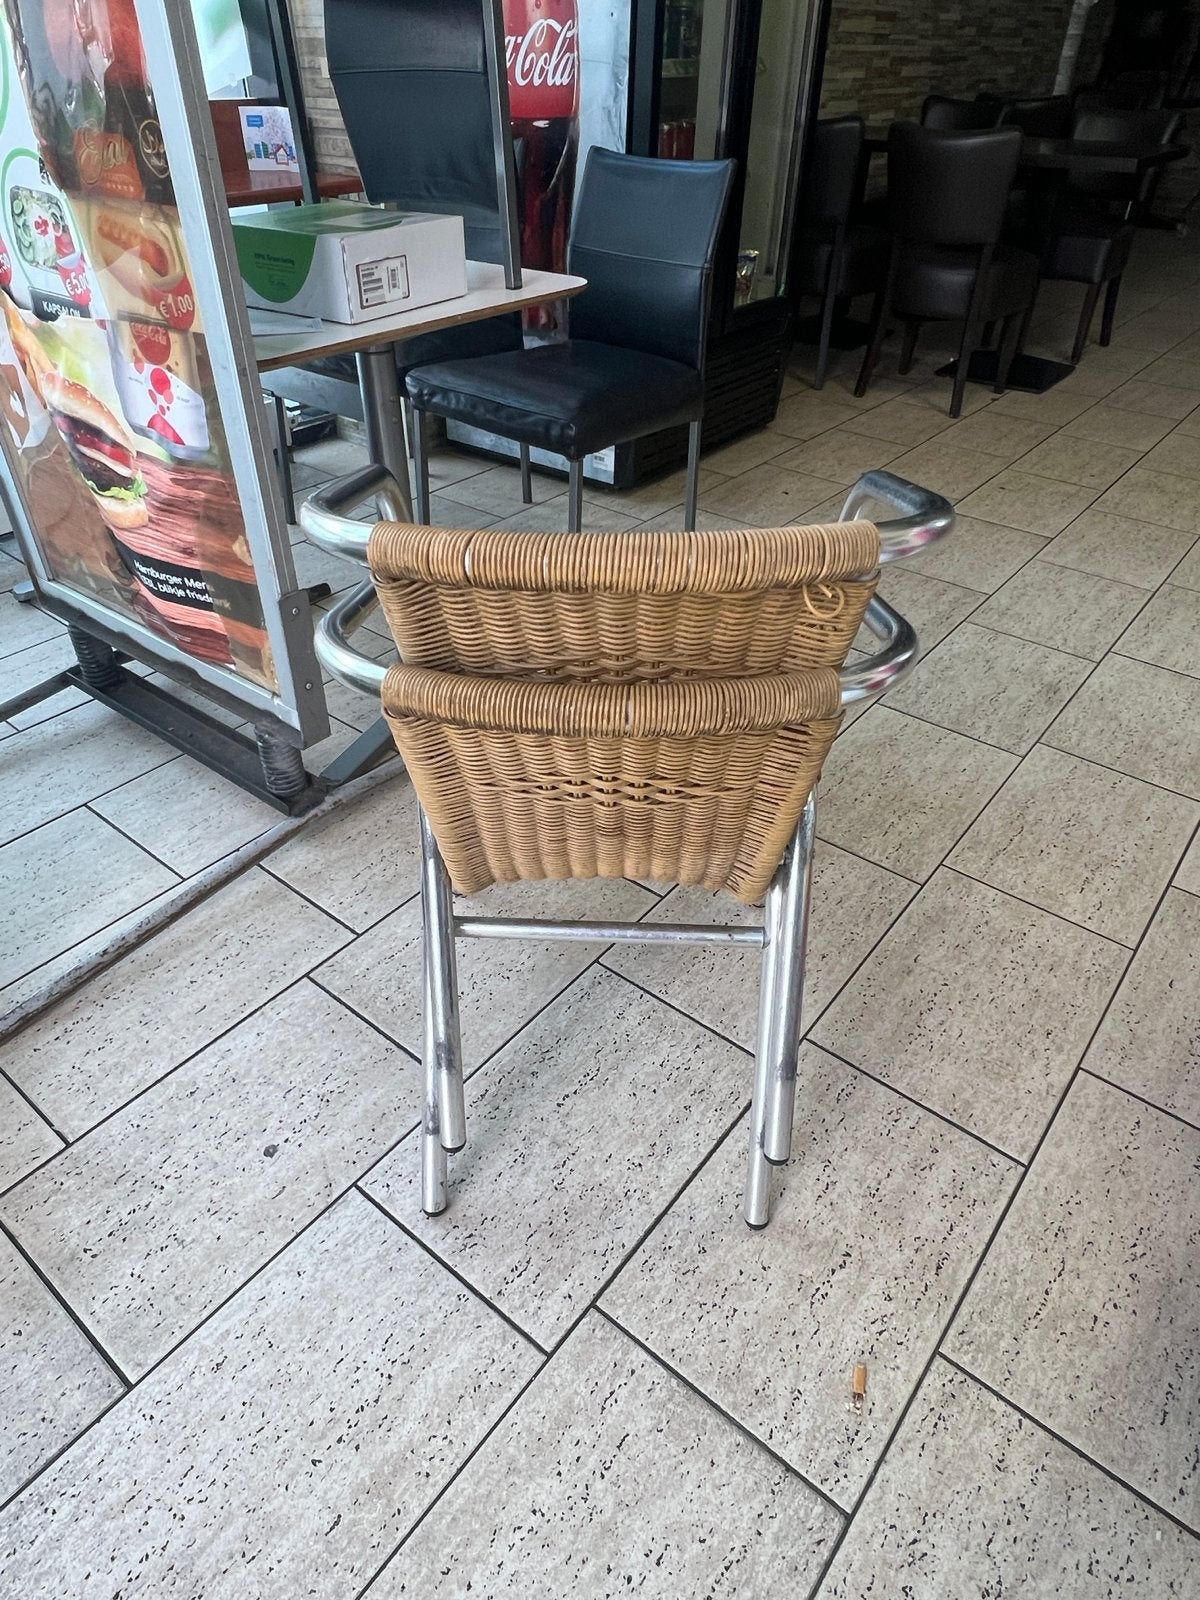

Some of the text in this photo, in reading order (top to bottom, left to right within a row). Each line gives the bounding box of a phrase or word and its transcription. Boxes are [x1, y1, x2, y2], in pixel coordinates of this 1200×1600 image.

[505, 18, 578, 87] a-Cola
[160, 293, 193, 318] €1,00
[133, 559, 183, 585] Hamburger
